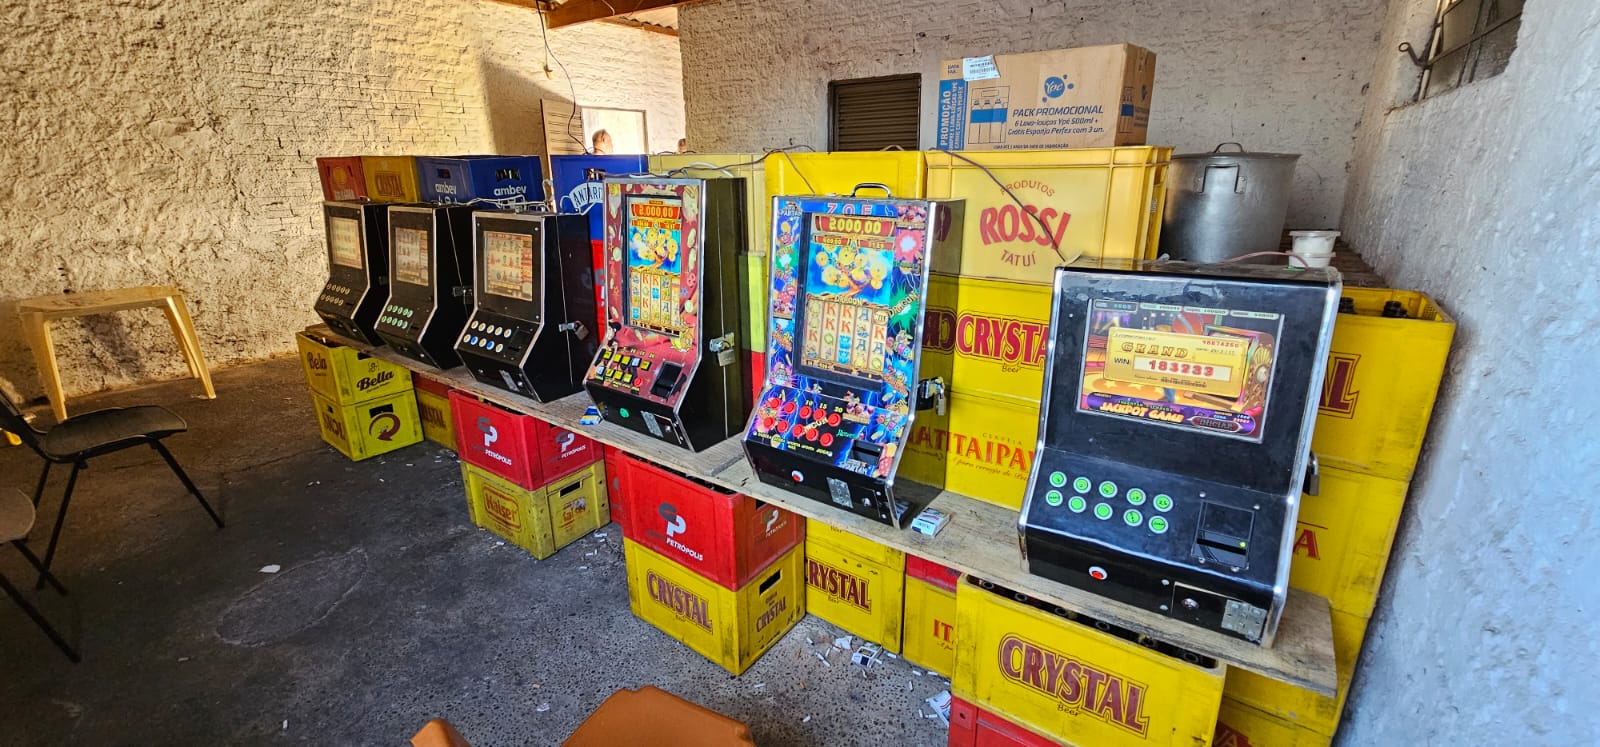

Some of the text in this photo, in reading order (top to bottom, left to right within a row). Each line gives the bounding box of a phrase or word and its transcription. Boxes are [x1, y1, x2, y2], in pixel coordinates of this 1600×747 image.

[940, 90, 951, 146] PROMOÇÃO
[1013, 105, 1103, 117] PACK PROMOCIONAL
[1025, 128, 1050, 136] Esponja
[1051, 127, 1071, 135] Perfex
[435, 182, 457, 194] ambev
[494, 185, 527, 196] ambev
[980, 204, 1071, 249] ROSSI
[1001, 363, 1020, 373] Beer
[1148, 359, 1214, 377] 183233
[356, 371, 394, 391] Bella
[1100, 402, 1148, 417] JACKPOT
[1148, 410, 1185, 423] GAME
[485, 448, 512, 465] PETRÓPOLIS
[485, 493, 516, 521] Kaiser
[666, 537, 703, 561] PETRÓPOLIS
[806, 558, 870, 610] RYSTAL
[647, 572, 713, 632] CRYSTAL
[756, 597, 787, 633] CRYSTAL
[934, 618, 954, 644] IT
[1003, 638, 1144, 731] CRYSTAL
[1057, 703, 1082, 717] Beer
